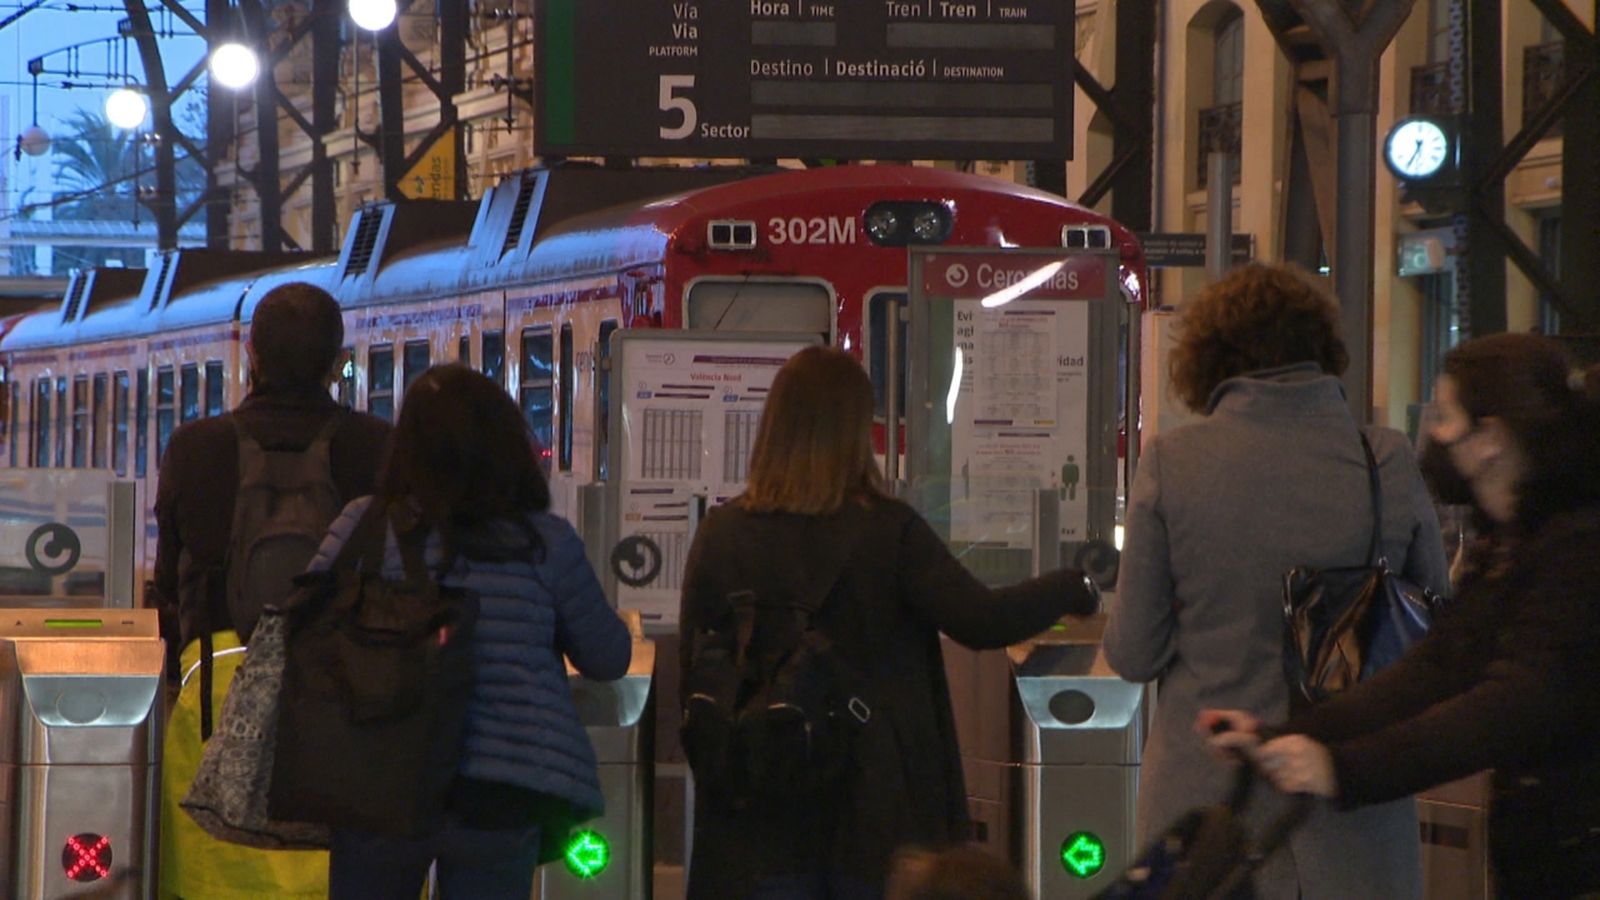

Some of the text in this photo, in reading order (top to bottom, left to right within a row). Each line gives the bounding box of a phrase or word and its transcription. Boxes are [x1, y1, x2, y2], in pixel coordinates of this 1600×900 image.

[673, 3, 698, 19] Vía
[751, 0, 835, 17] Hora TIME
[886, 1, 1027, 18] Tren Tren TRAIN
[672, 23, 698, 39] Via
[649, 46, 698, 56] PLATFORM
[751, 59, 1004, 77] Destino Destinació DESTINATION
[659, 75, 698, 140] 5
[701, 122, 750, 138] Sector
[768, 216, 856, 245] 302M
